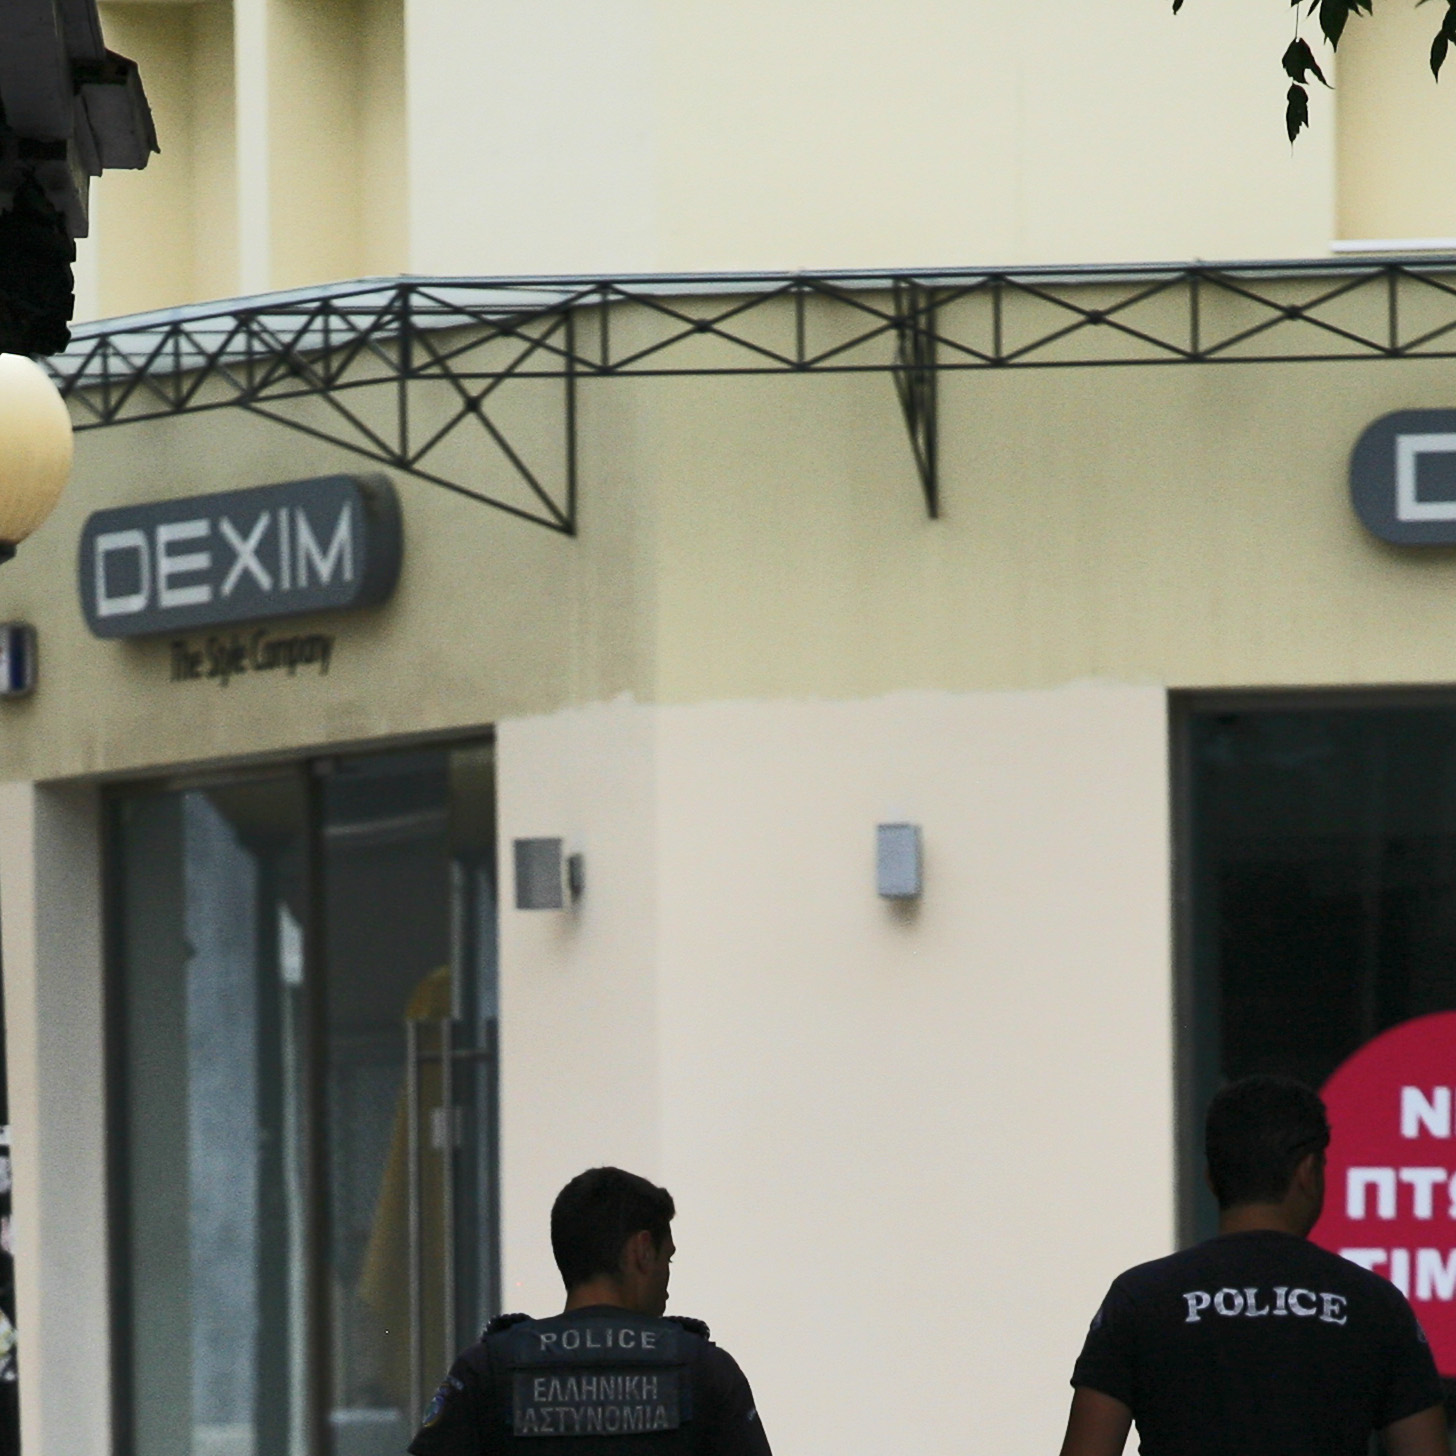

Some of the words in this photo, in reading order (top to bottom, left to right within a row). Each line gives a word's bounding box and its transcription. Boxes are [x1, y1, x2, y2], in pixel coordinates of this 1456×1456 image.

[95, 501, 355, 618] DEXIM
[170, 639, 203, 682] The
[1183, 1286, 1348, 1325] POLICE
[540, 1328, 656, 1351] POLICE
[534, 1376, 658, 1402] ΕΛΛΗΝΙΚΗ
[521, 1404, 670, 1434] ΑΣΤΥΝΟΜΙΑ
